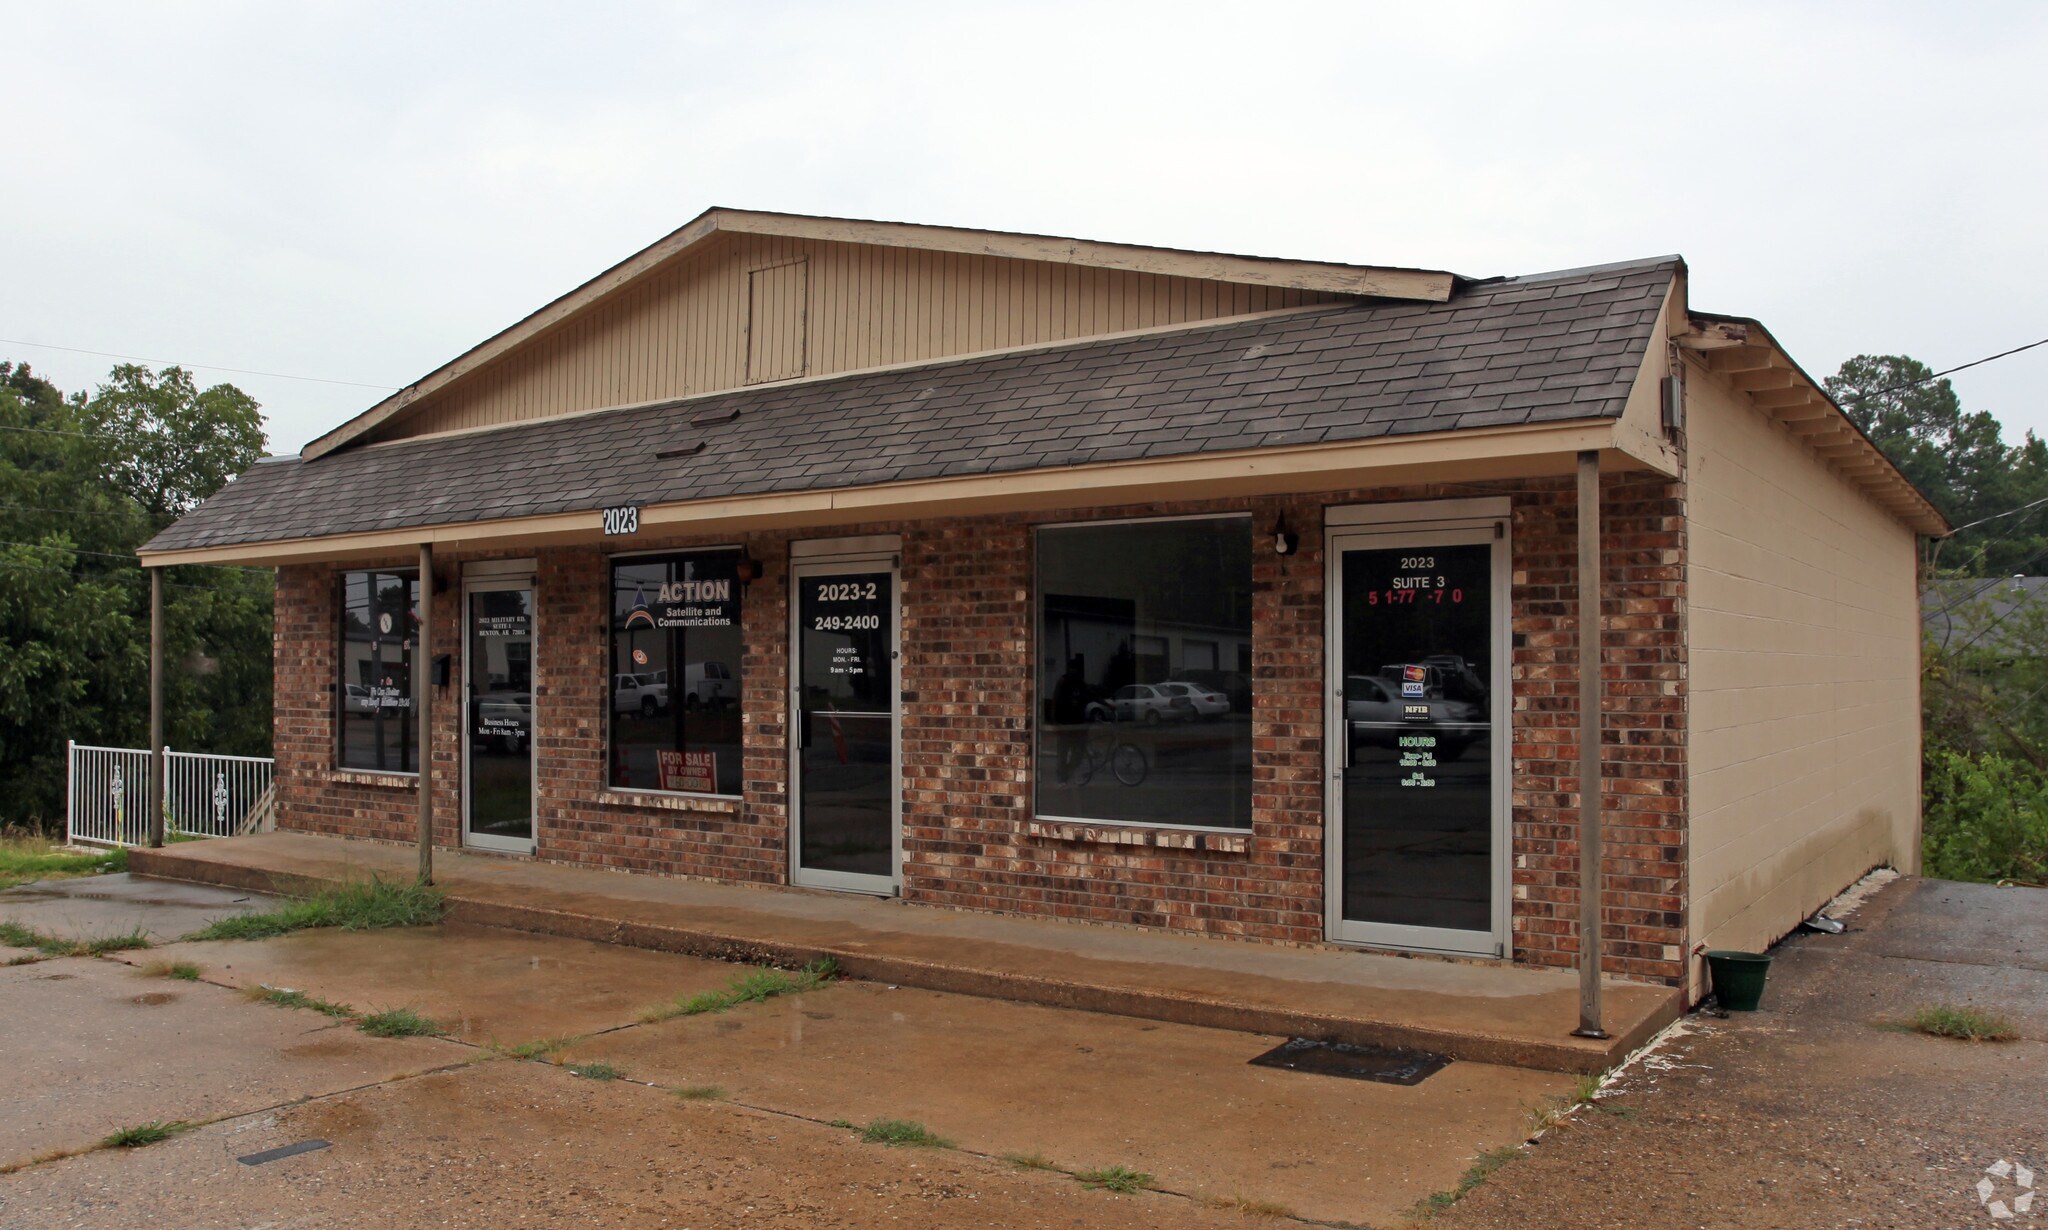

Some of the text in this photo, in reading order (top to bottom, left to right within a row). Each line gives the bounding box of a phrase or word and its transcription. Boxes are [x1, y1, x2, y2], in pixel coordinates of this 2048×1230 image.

[603, 506, 638, 535] 2023
[1401, 557, 1435, 569] 2023
[1393, 576, 1445, 589] SUITE 3
[657, 579, 730, 603] ACTION
[818, 582, 877, 601] 2023-2
[666, 607, 722, 617] Satellite and
[657, 617, 731, 627] Communications
[815, 615, 879, 630] 249-2400
[1399, 736, 1436, 747] HOURS
[662, 752, 711, 766] FOR SALE
[668, 766, 708, 776] BY OWNER
